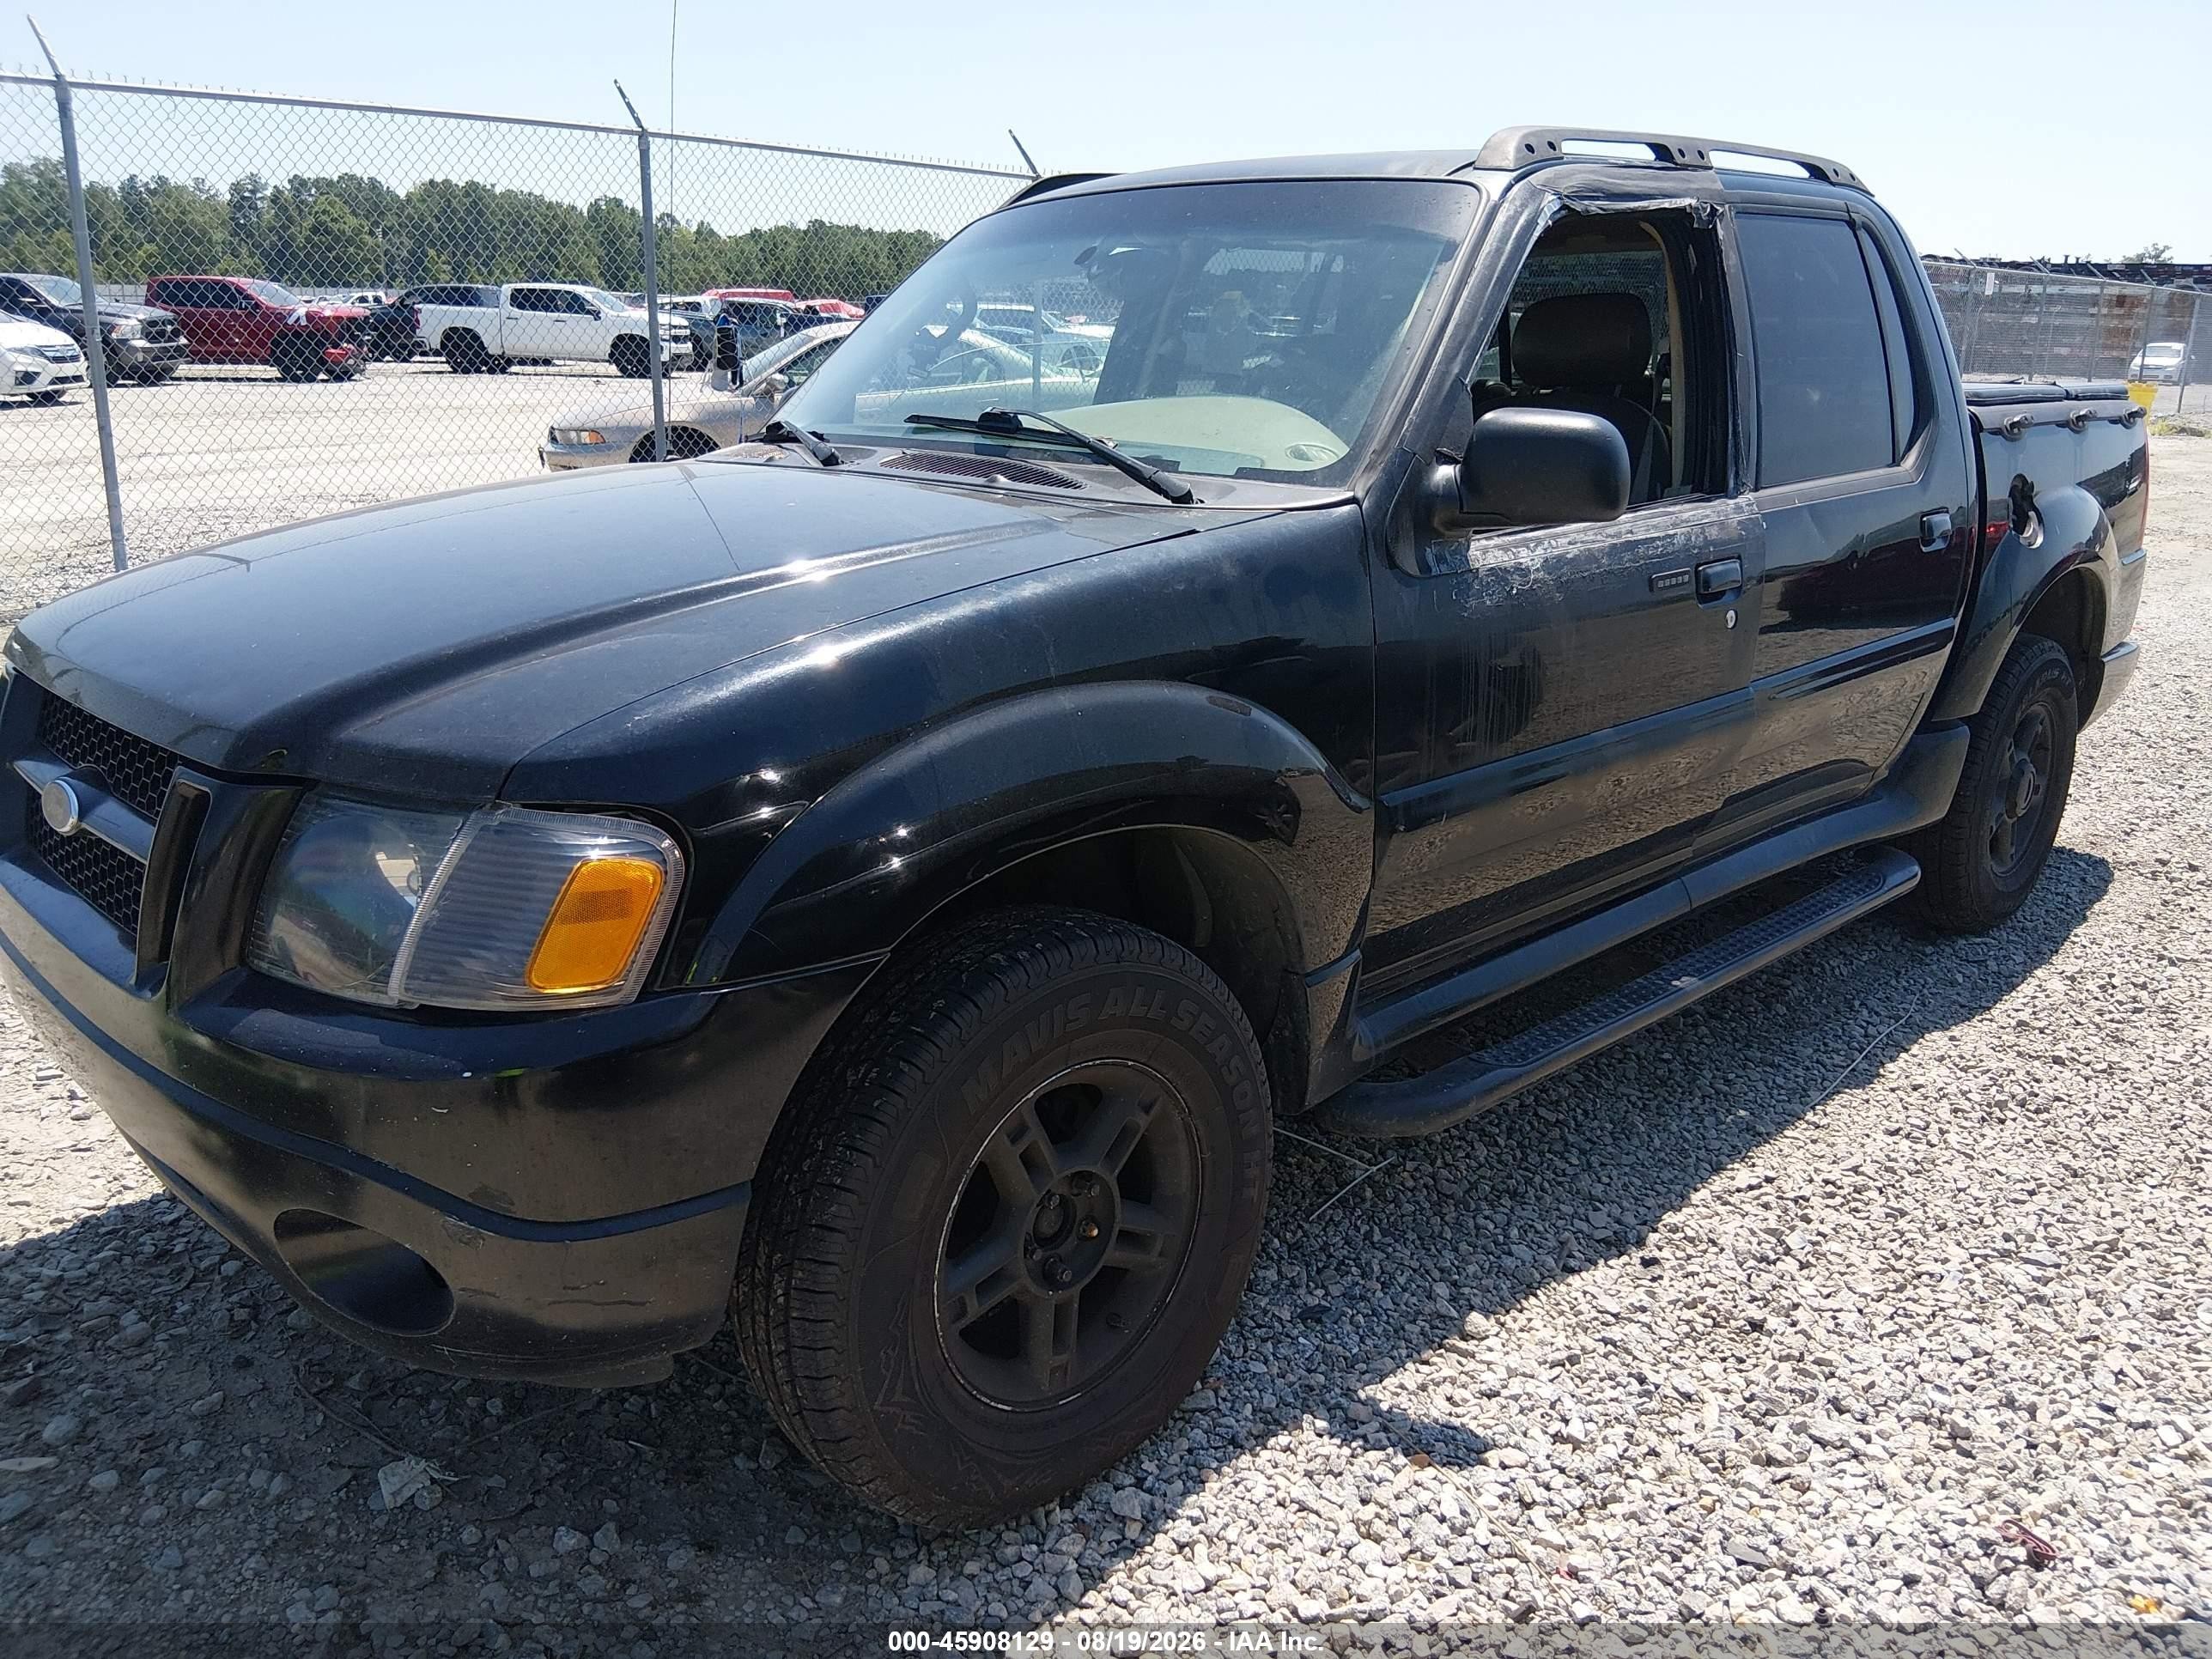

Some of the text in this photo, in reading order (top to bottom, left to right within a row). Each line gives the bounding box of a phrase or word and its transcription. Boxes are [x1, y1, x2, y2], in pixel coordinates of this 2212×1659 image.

[961, 992, 1091, 1115] MAVIS
[1097, 985, 1168, 1021] ALL
[1170, 999, 1262, 1140] SEASON
